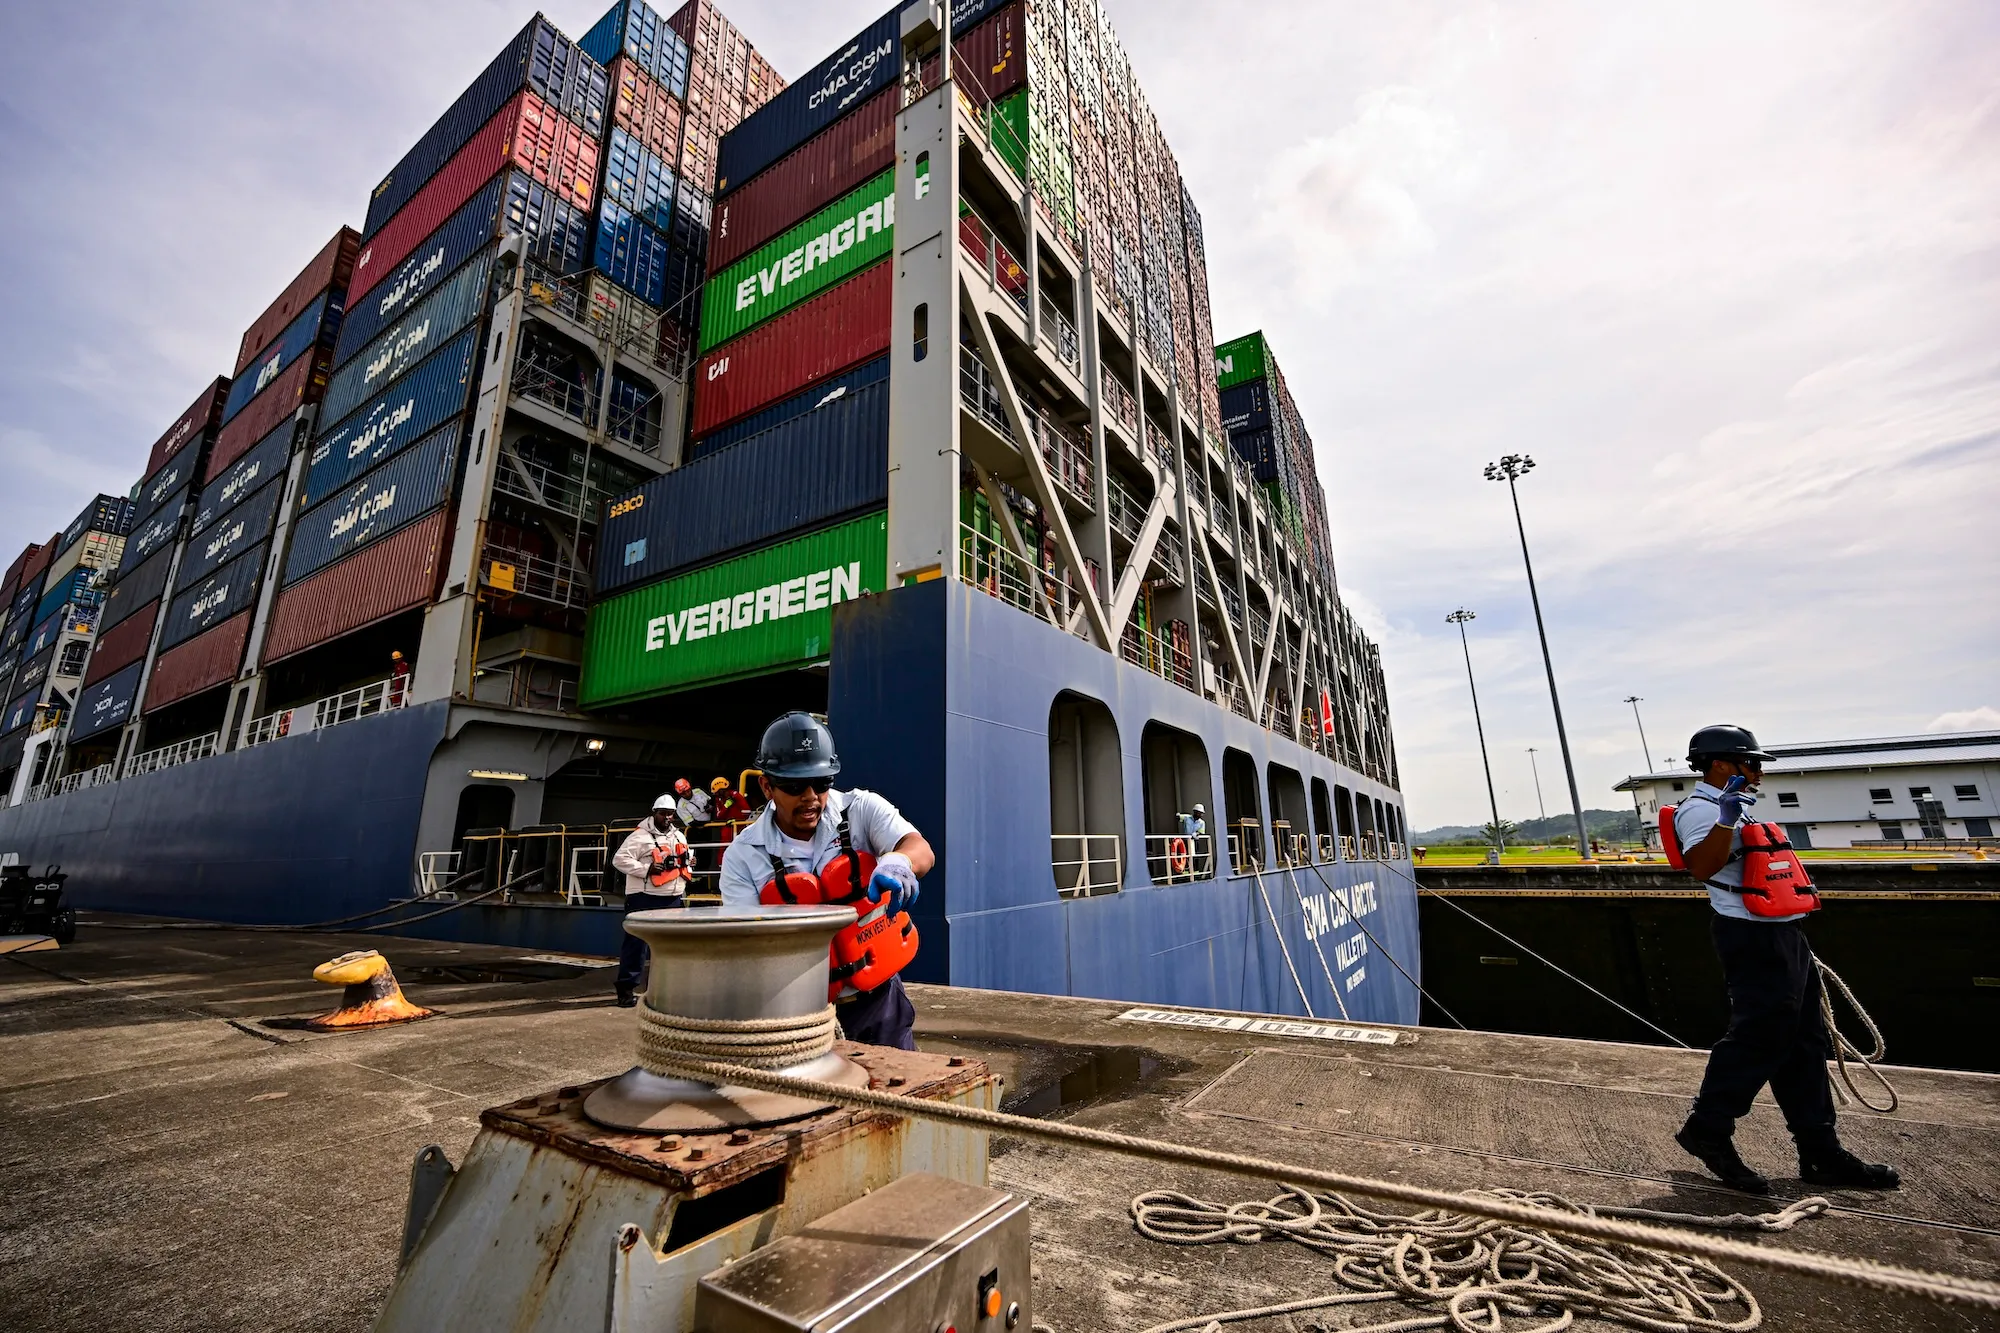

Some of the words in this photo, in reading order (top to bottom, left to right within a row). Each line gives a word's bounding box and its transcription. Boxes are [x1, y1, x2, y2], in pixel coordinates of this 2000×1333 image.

[809, 74, 848, 109] CMA
[849, 39, 892, 80] CGM
[736, 192, 895, 311] EVERGR
[379, 279, 408, 315] CMA
[409, 247, 444, 288] CGM
[364, 348, 392, 383] CMA
[395, 319, 430, 358] CGM
[708, 356, 729, 381] CAI
[347, 424, 376, 459] CMA
[378, 399, 414, 437] CGM
[1222, 413, 1250, 426] ontainer
[329, 506, 359, 539] CMA
[360, 484, 396, 521] CGM
[609, 494, 644, 518] seaco
[645, 561, 861, 652] EVERGREEN
[1765, 871, 1794, 881] KENT
[856, 926, 874, 945] WORK
[873, 919, 887, 936] VEST
[1302, 893, 1330, 940] CMA
[1329, 886, 1351, 929] CGM
[1350, 881, 1377, 919] ARCTIC
[1335, 931, 1368, 972] VALLETTA
